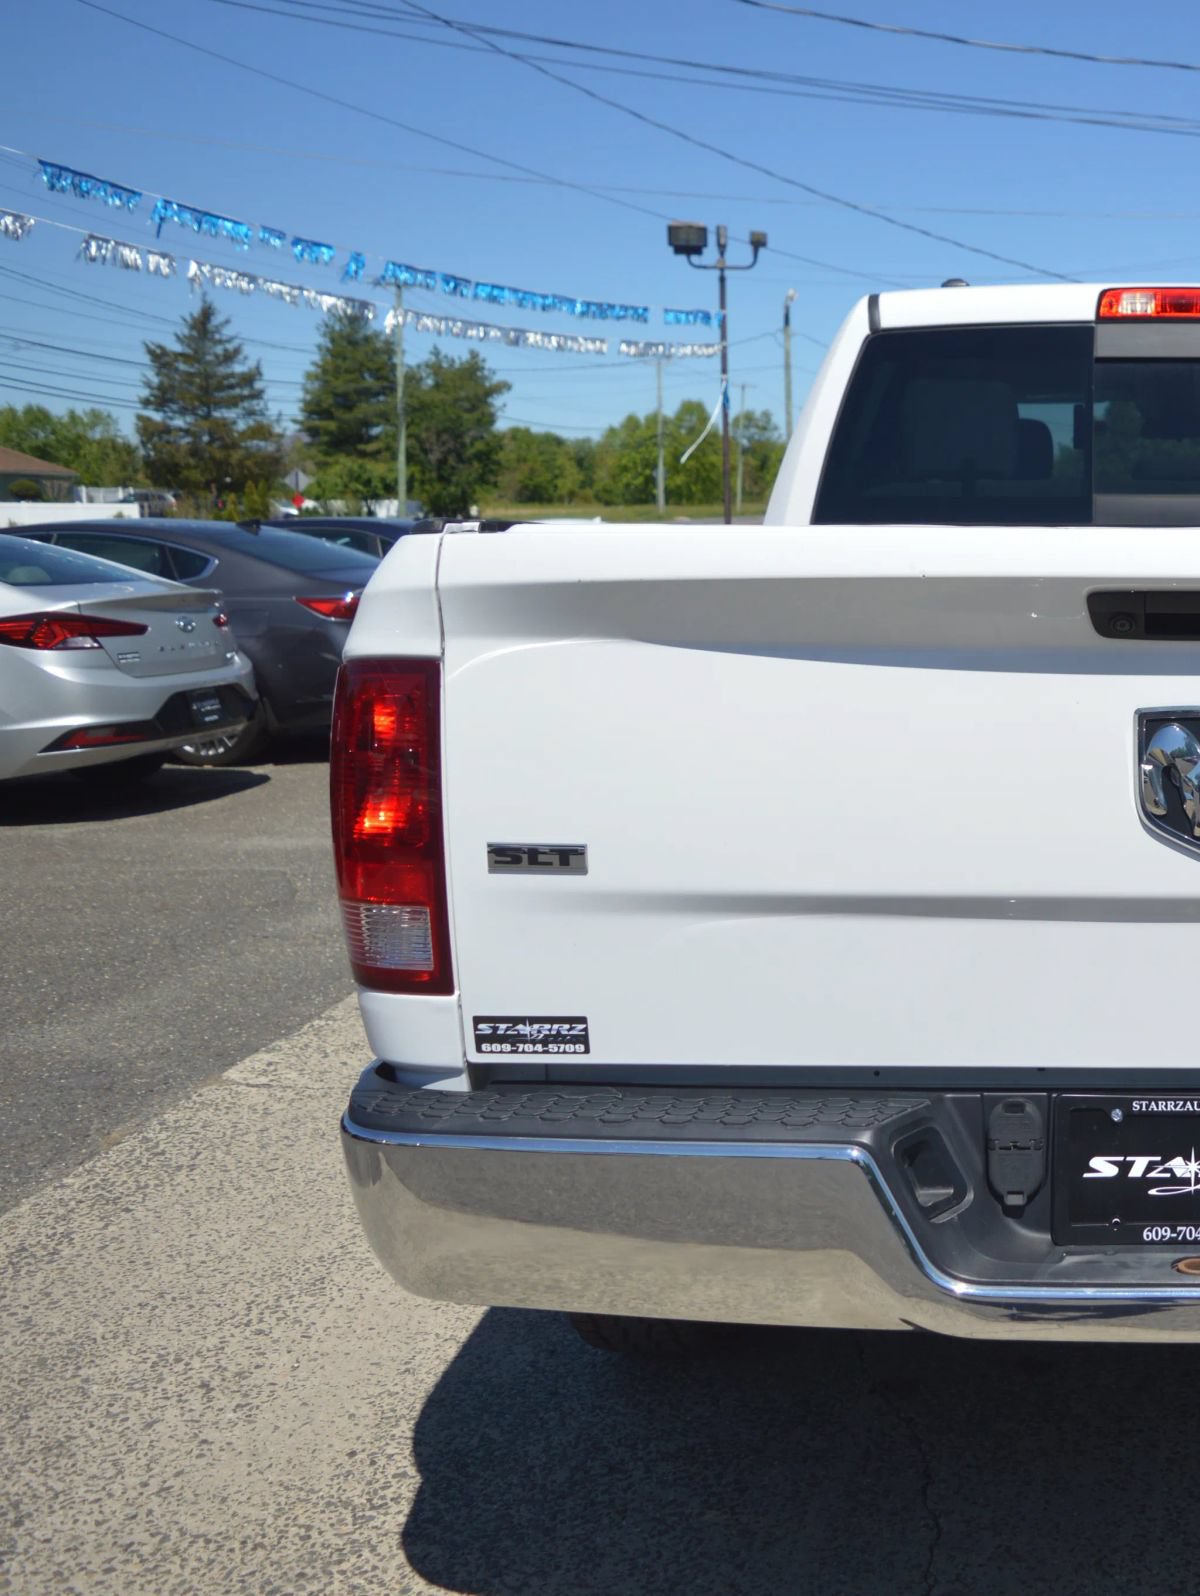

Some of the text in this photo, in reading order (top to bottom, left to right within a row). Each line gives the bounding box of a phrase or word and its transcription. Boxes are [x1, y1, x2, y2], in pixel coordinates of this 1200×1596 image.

[488, 847, 585, 867] SLT
[475, 1023, 587, 1034] STARRZ
[481, 1043, 585, 1053] 609-704-5709
